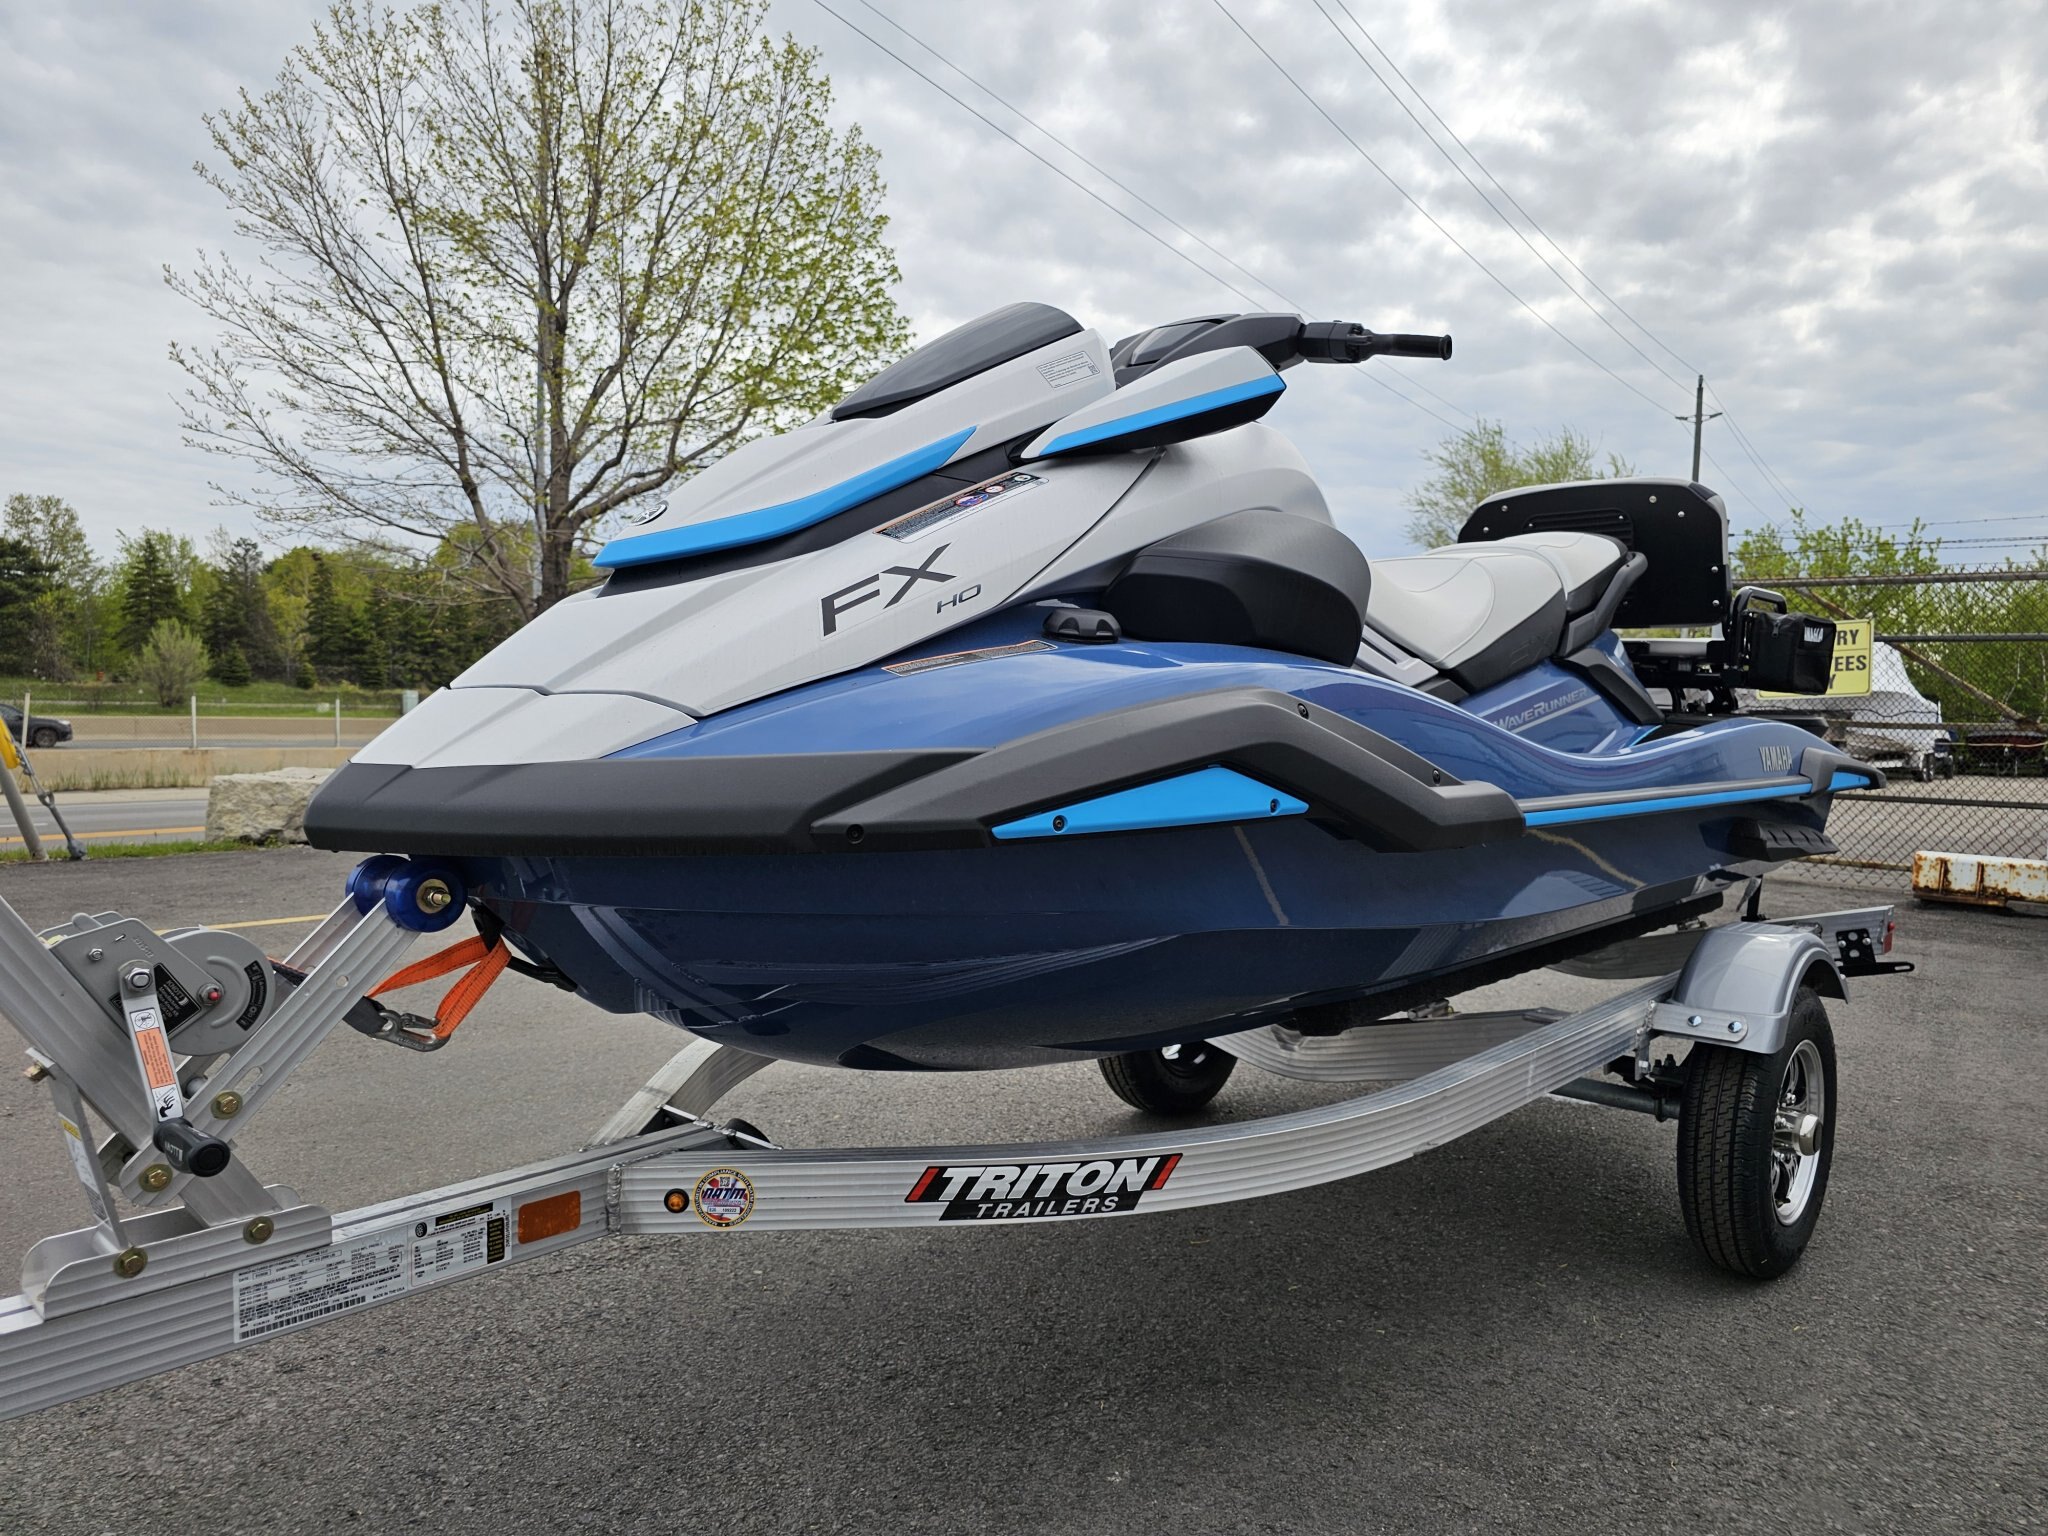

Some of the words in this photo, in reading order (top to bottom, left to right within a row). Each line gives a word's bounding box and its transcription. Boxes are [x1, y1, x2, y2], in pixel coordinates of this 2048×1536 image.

[821, 543, 957, 636] FX
[937, 583, 982, 614] HO
[1836, 629, 1859, 646] RY
[1834, 655, 1867, 672] EES
[1759, 746, 1793, 772] YAMAHA
[938, 1157, 1161, 1201] TRITON
[976, 1196, 1119, 1219] TRAILERS
